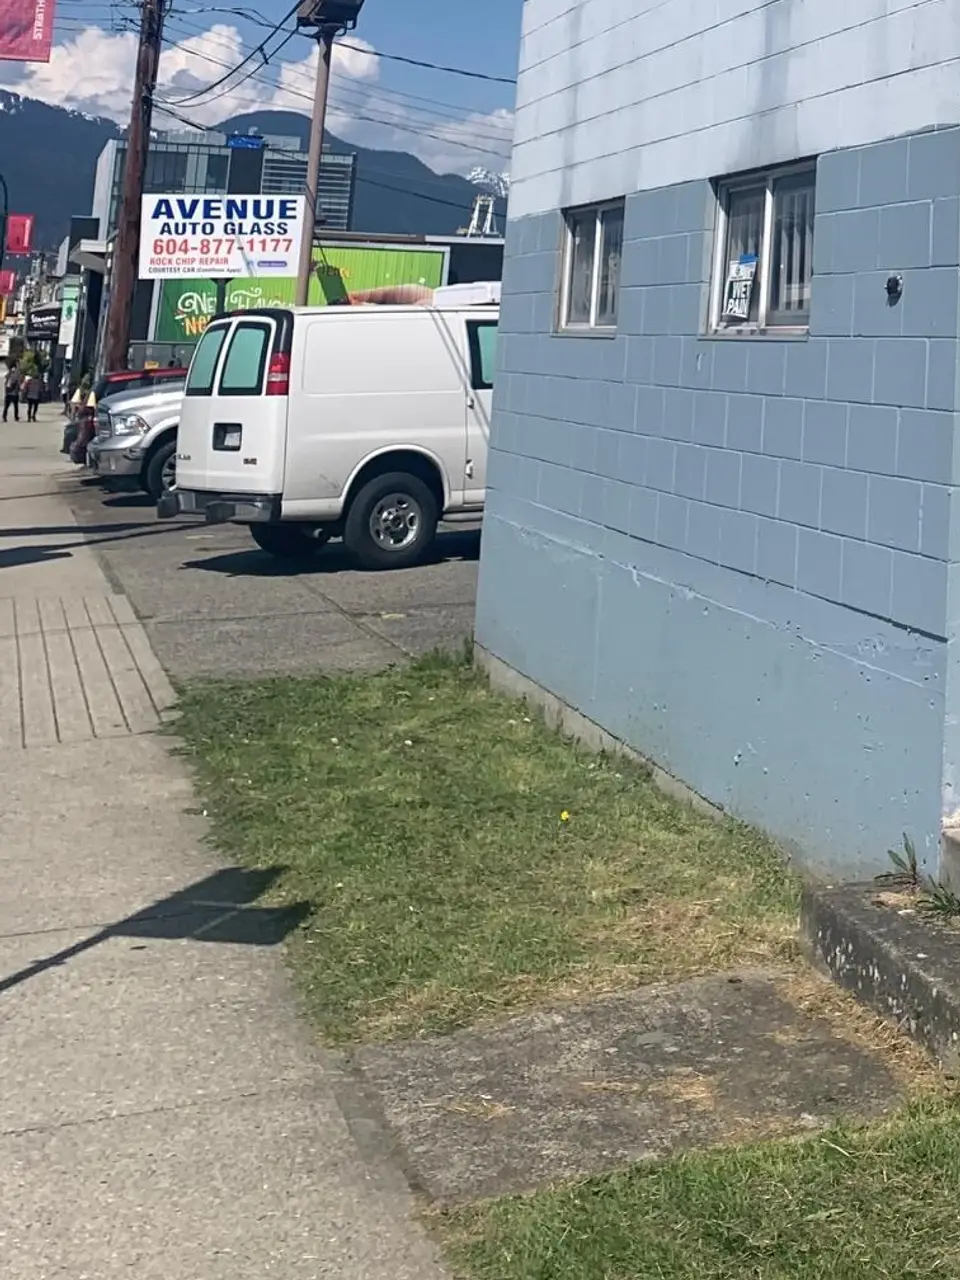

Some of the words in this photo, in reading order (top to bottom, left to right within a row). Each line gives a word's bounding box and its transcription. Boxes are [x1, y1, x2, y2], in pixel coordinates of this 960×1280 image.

[152, 199, 297, 220] AVENUE
[159, 222, 215, 235] AUTO
[223, 222, 288, 235] GLASS
[153, 238, 293, 255] 604-877-1177
[150, 257, 173, 265] ROCK
[175, 257, 196, 265] CHIP
[199, 257, 229, 265] REPAIR
[727, 298, 749, 314] PAIN
